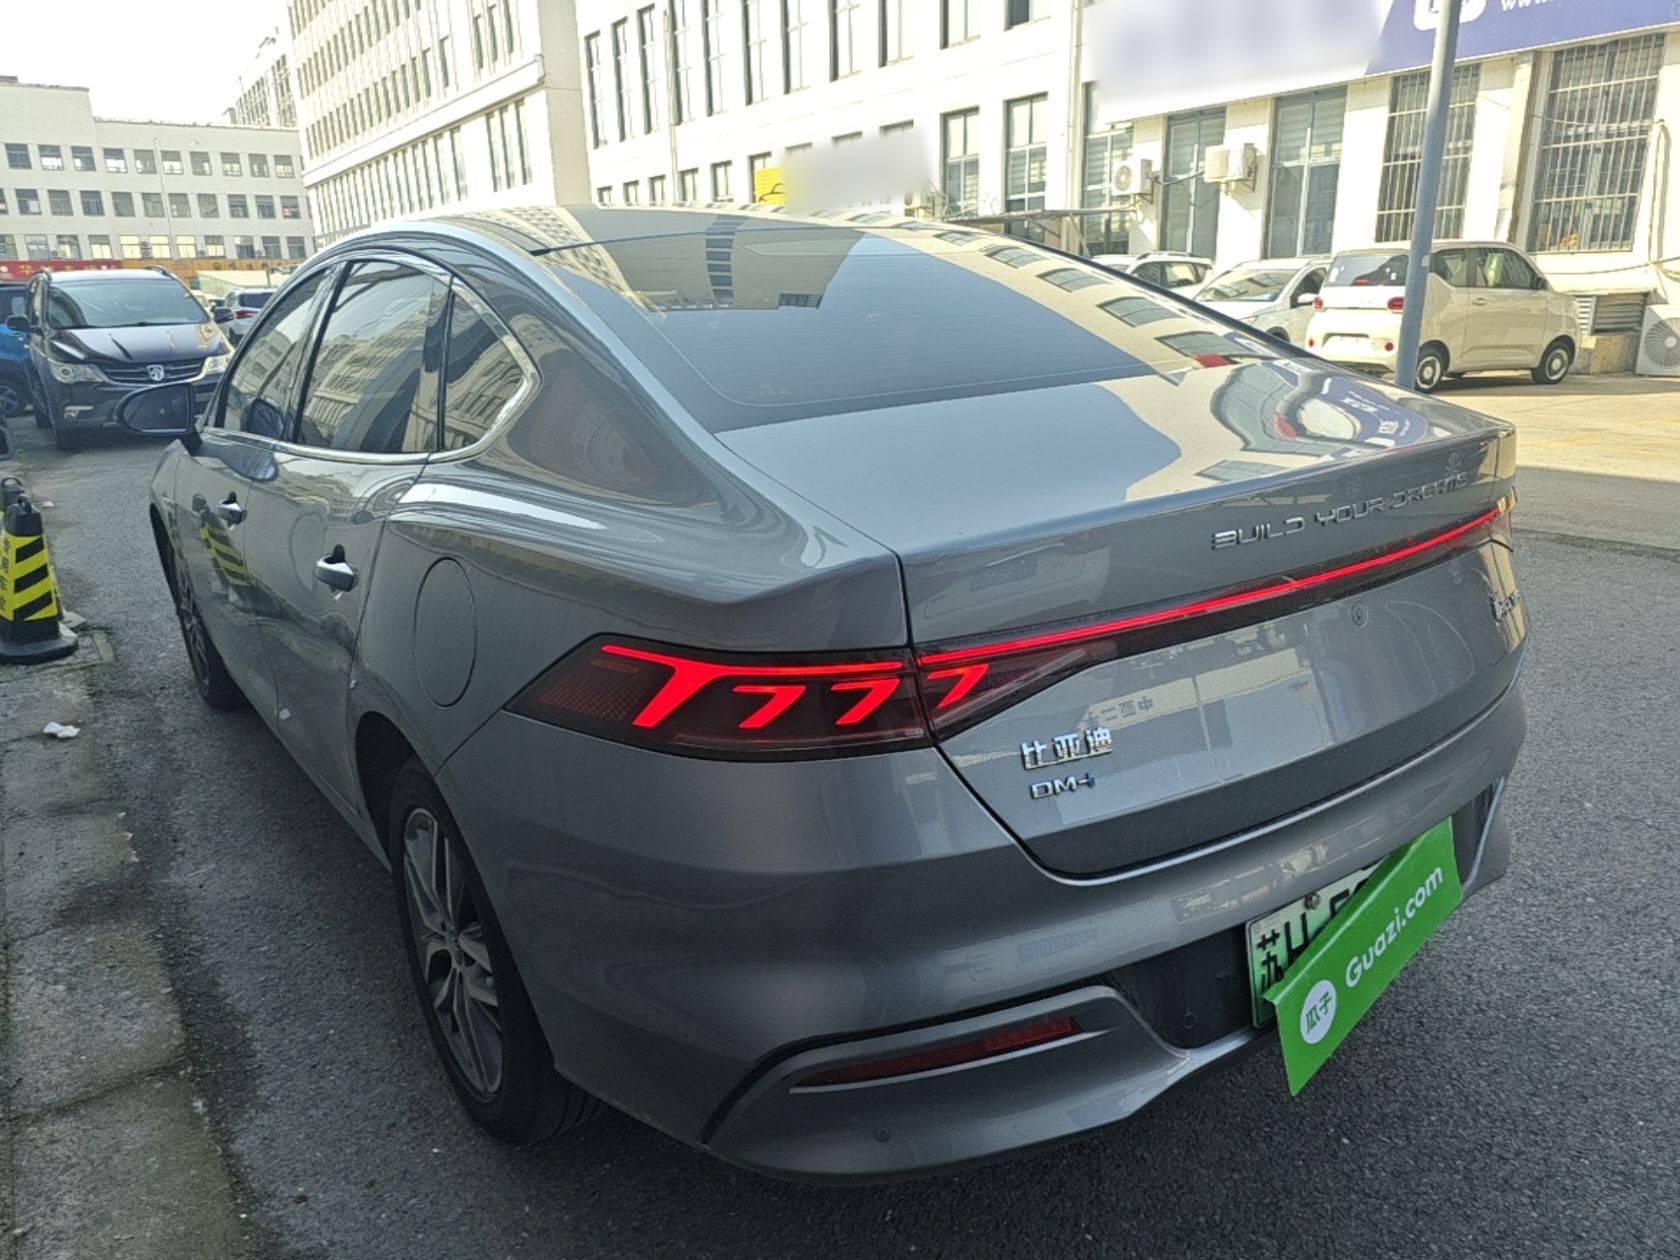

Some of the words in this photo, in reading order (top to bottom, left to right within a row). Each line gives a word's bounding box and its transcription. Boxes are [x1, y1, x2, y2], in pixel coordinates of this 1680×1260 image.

[1212, 517, 1305, 549] BUILD
[1315, 497, 1386, 526] YOUR
[1391, 472, 1469, 509] DREAMS
[1022, 728, 1113, 769] 比亚迪
[1305, 991, 1333, 1034] 瓜子
[1345, 867, 1443, 987] Guazi.com
